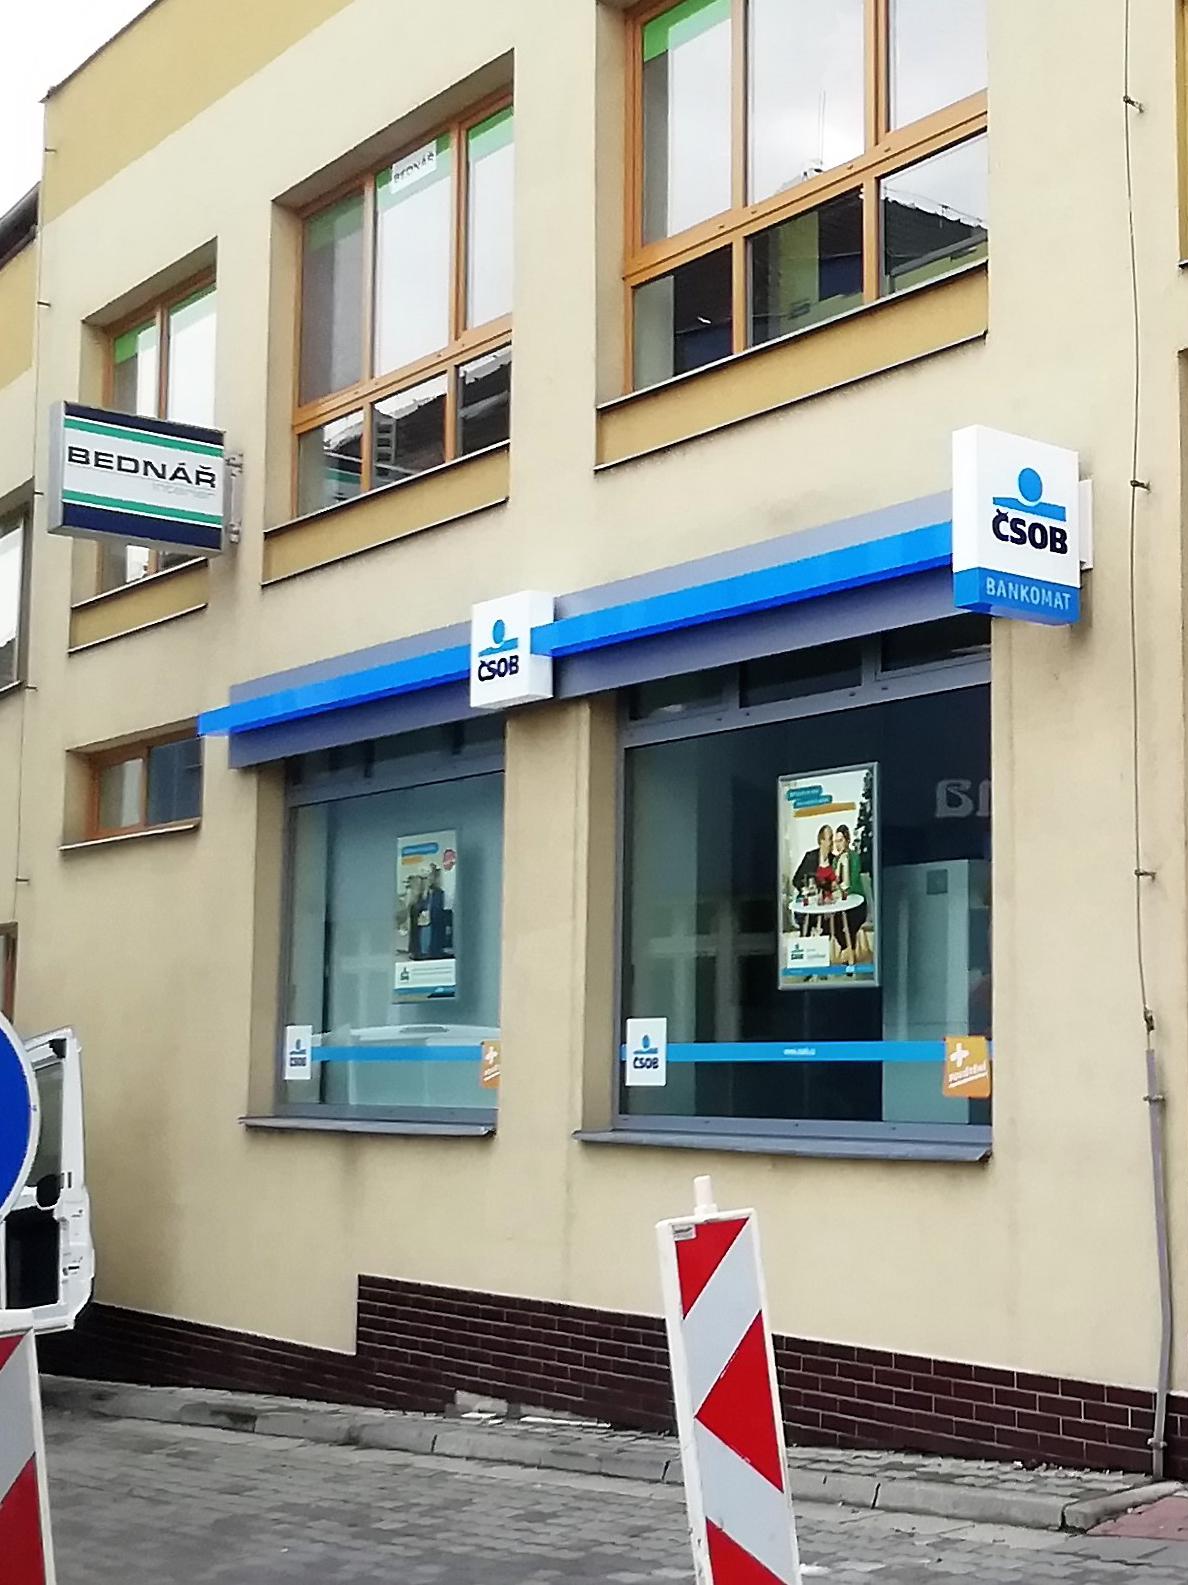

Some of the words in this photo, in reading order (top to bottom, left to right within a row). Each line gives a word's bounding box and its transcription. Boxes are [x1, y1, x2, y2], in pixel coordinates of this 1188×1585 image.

[67, 445, 217, 488] BEDNÁŘ
[992, 508, 1068, 554] ČSOB
[986, 577, 1071, 610] BANKOMAT
[477, 654, 520, 681] ČSOB
